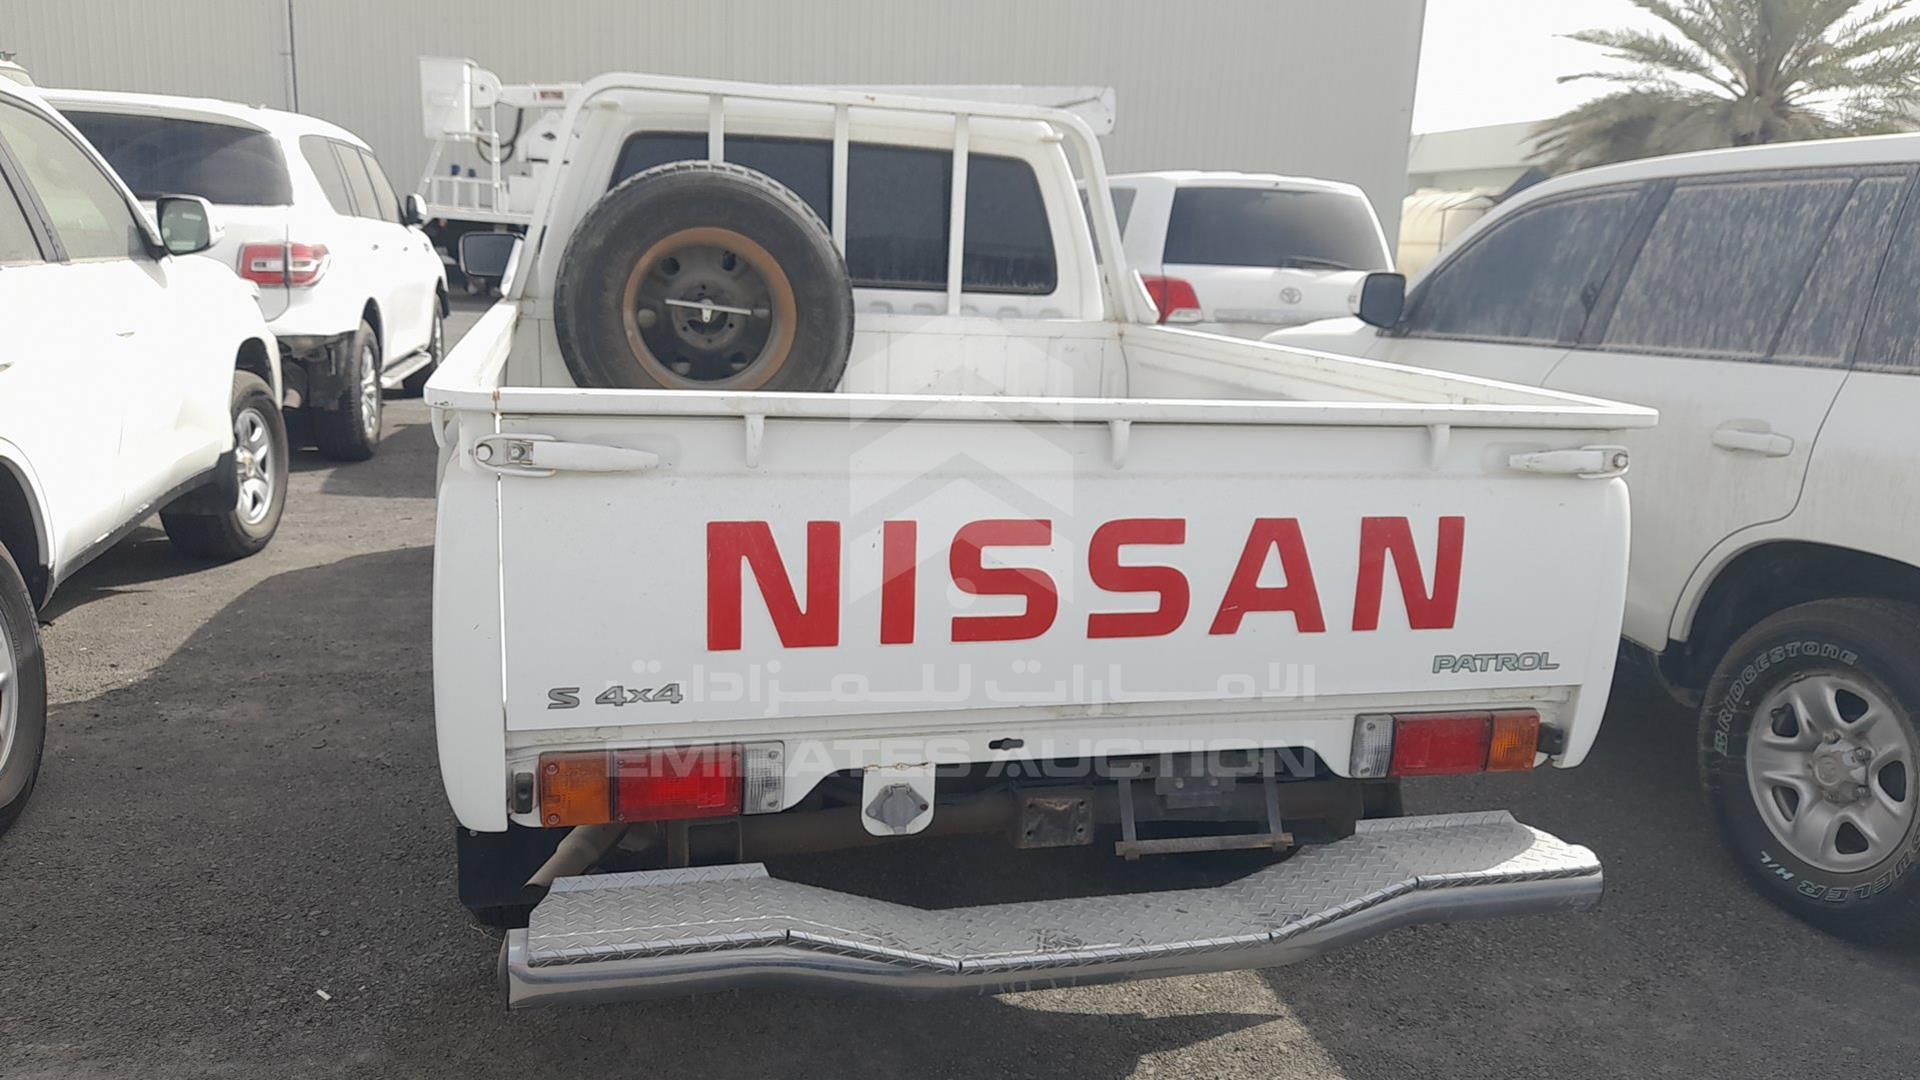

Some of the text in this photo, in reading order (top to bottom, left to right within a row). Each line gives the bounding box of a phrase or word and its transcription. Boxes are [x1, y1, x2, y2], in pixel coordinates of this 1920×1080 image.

[706, 517, 1464, 650] NISSAN
[547, 683, 683, 709] S 4x4
[1432, 651, 1560, 674] PATROL
[1713, 640, 1858, 757] BRIDGESTONE
